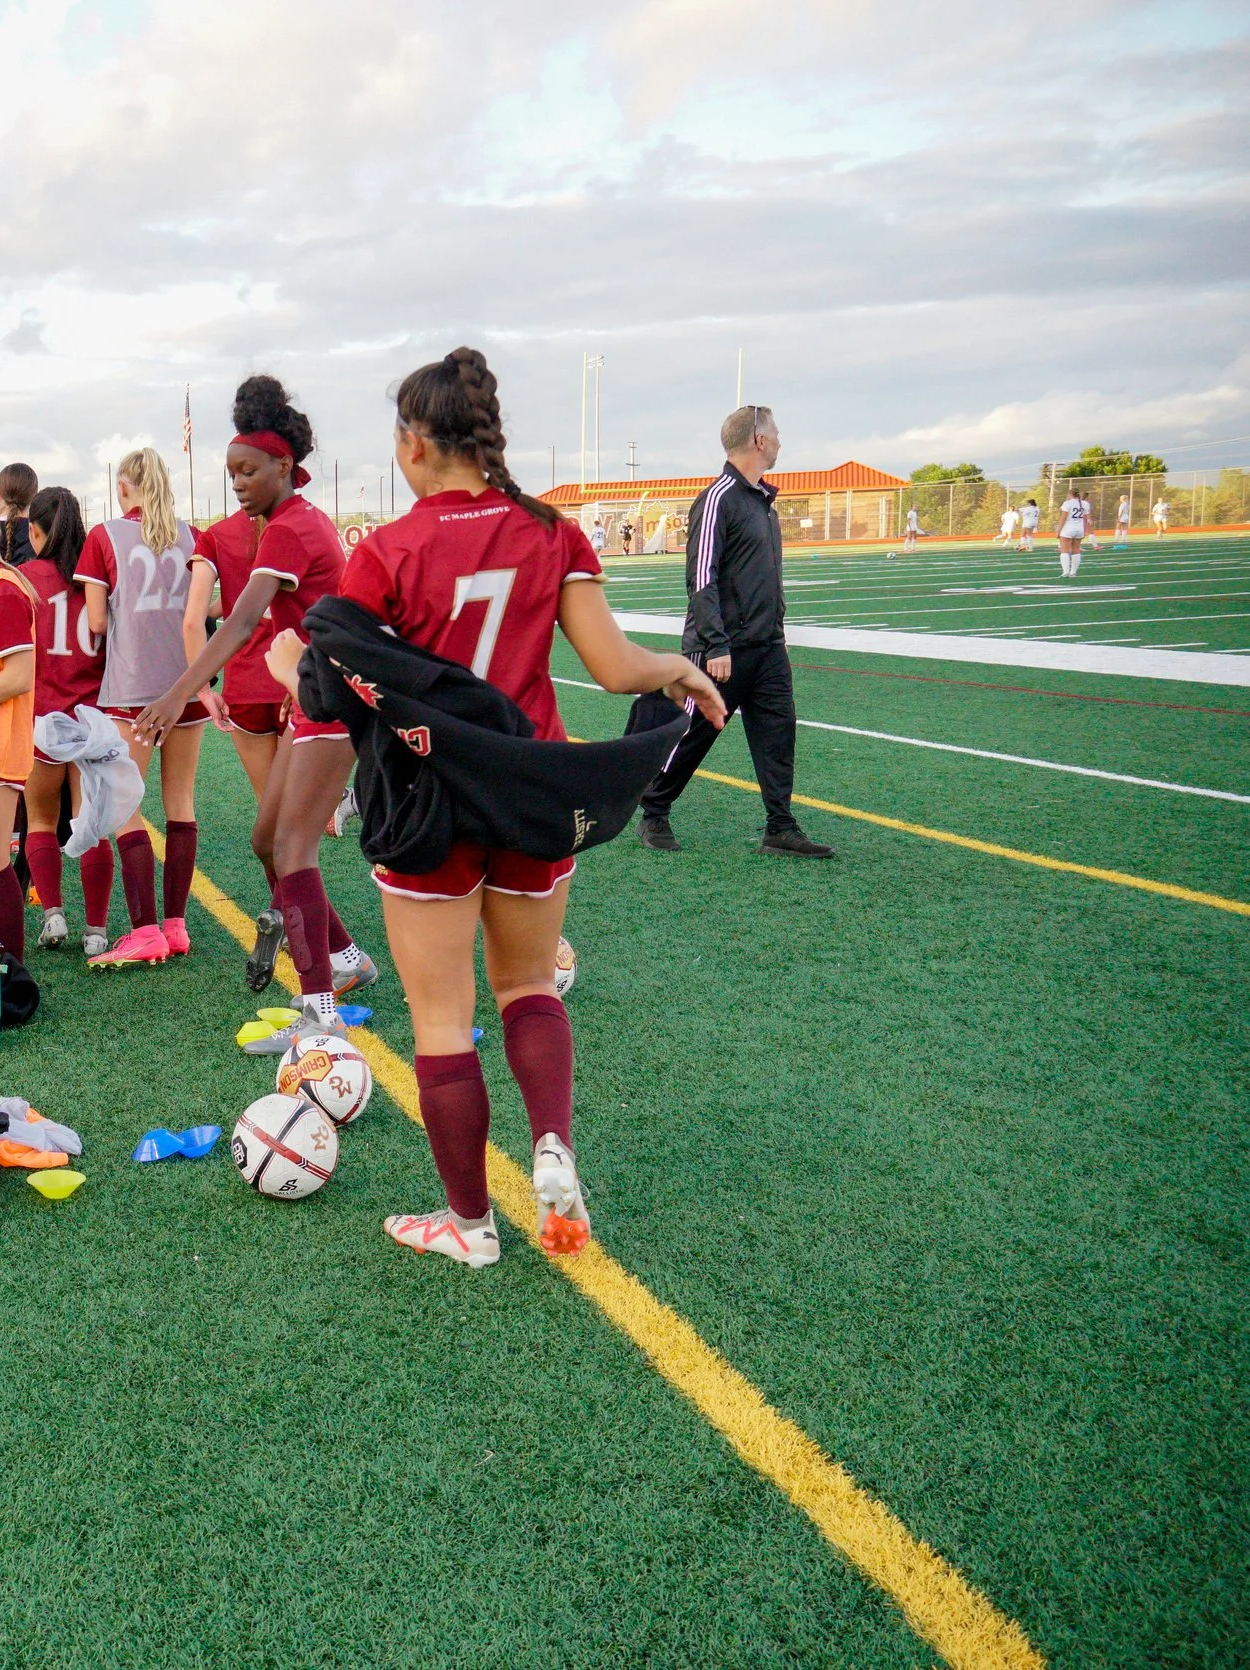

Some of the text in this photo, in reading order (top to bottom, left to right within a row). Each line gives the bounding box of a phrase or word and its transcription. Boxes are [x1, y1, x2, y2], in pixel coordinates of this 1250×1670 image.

[439, 505, 510, 522] FC MAPLE GROVE
[1071, 507, 1085, 519] 22
[127, 544, 187, 613] 22
[449, 567, 518, 680] 7
[280, 1055, 327, 1092] CRIMSON
